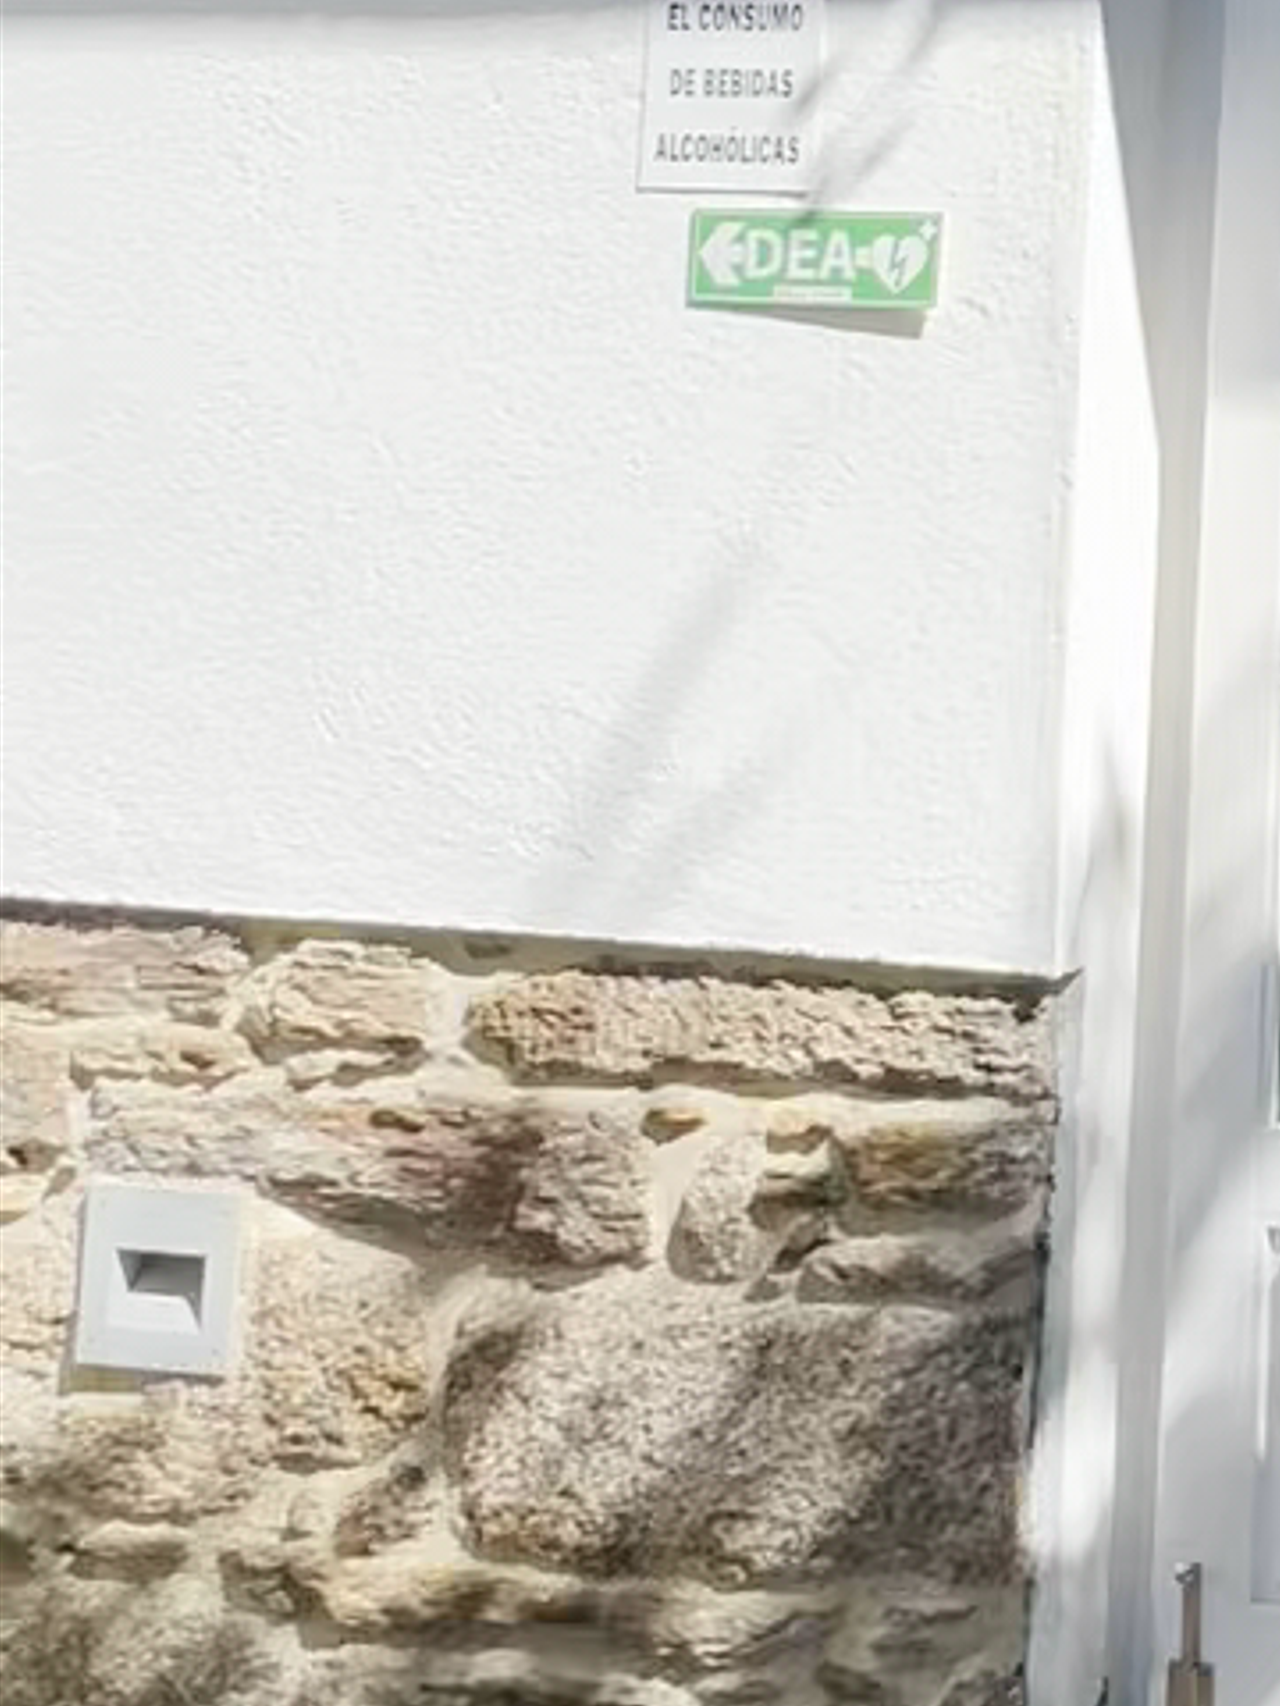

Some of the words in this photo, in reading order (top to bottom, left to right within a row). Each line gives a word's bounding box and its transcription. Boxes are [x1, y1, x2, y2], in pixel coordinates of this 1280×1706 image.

[667, 3, 691, 31] EL
[699, 3, 804, 32] CONSUMO
[669, 69, 696, 97] DE
[702, 69, 794, 98] BEBIDAS
[744, 228, 857, 280] DEA
